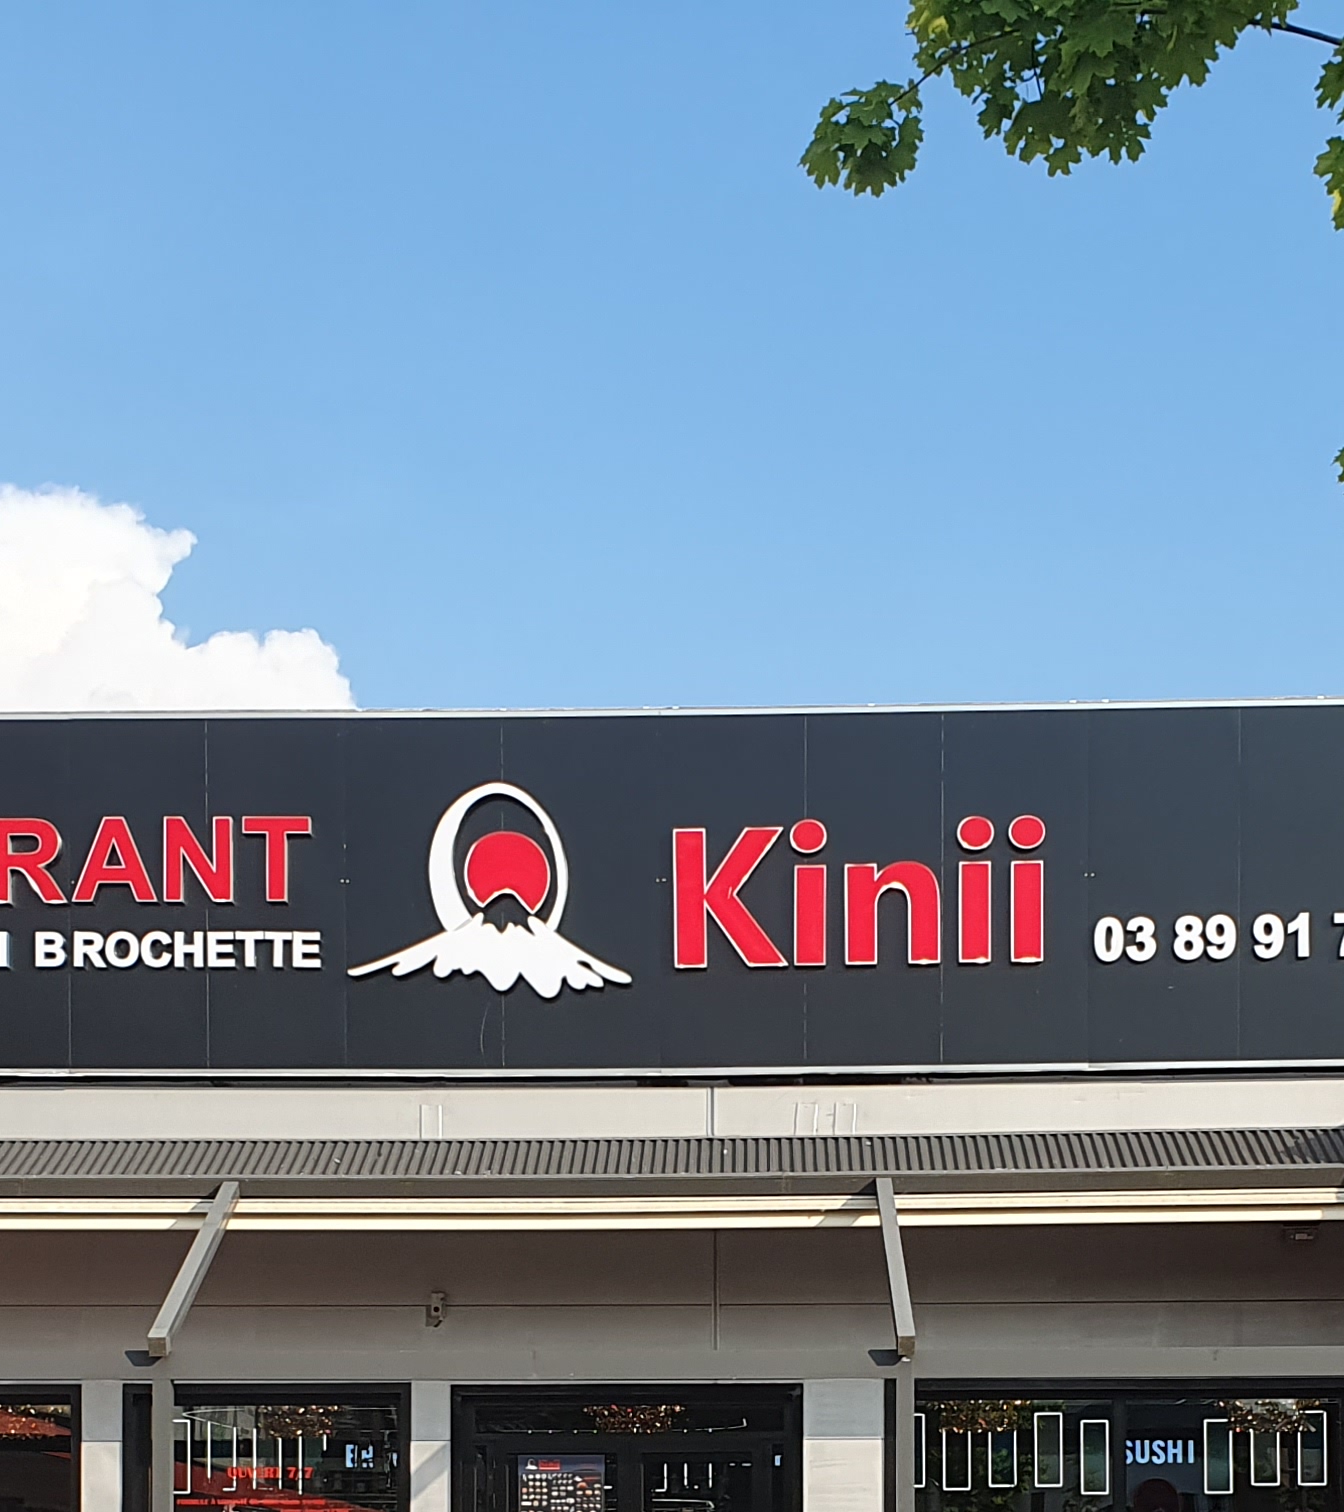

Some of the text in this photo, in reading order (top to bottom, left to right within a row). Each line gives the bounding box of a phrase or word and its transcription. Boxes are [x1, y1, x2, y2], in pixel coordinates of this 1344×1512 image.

[671, 814, 1047, 970] Kinii
[34, 930, 322, 968] BROCHETTE
[1093, 915, 1158, 963] 03
[1172, 914, 1238, 961] 89
[1252, 911, 1312, 960] 91
[1125, 1439, 1195, 1465] SUSHI
